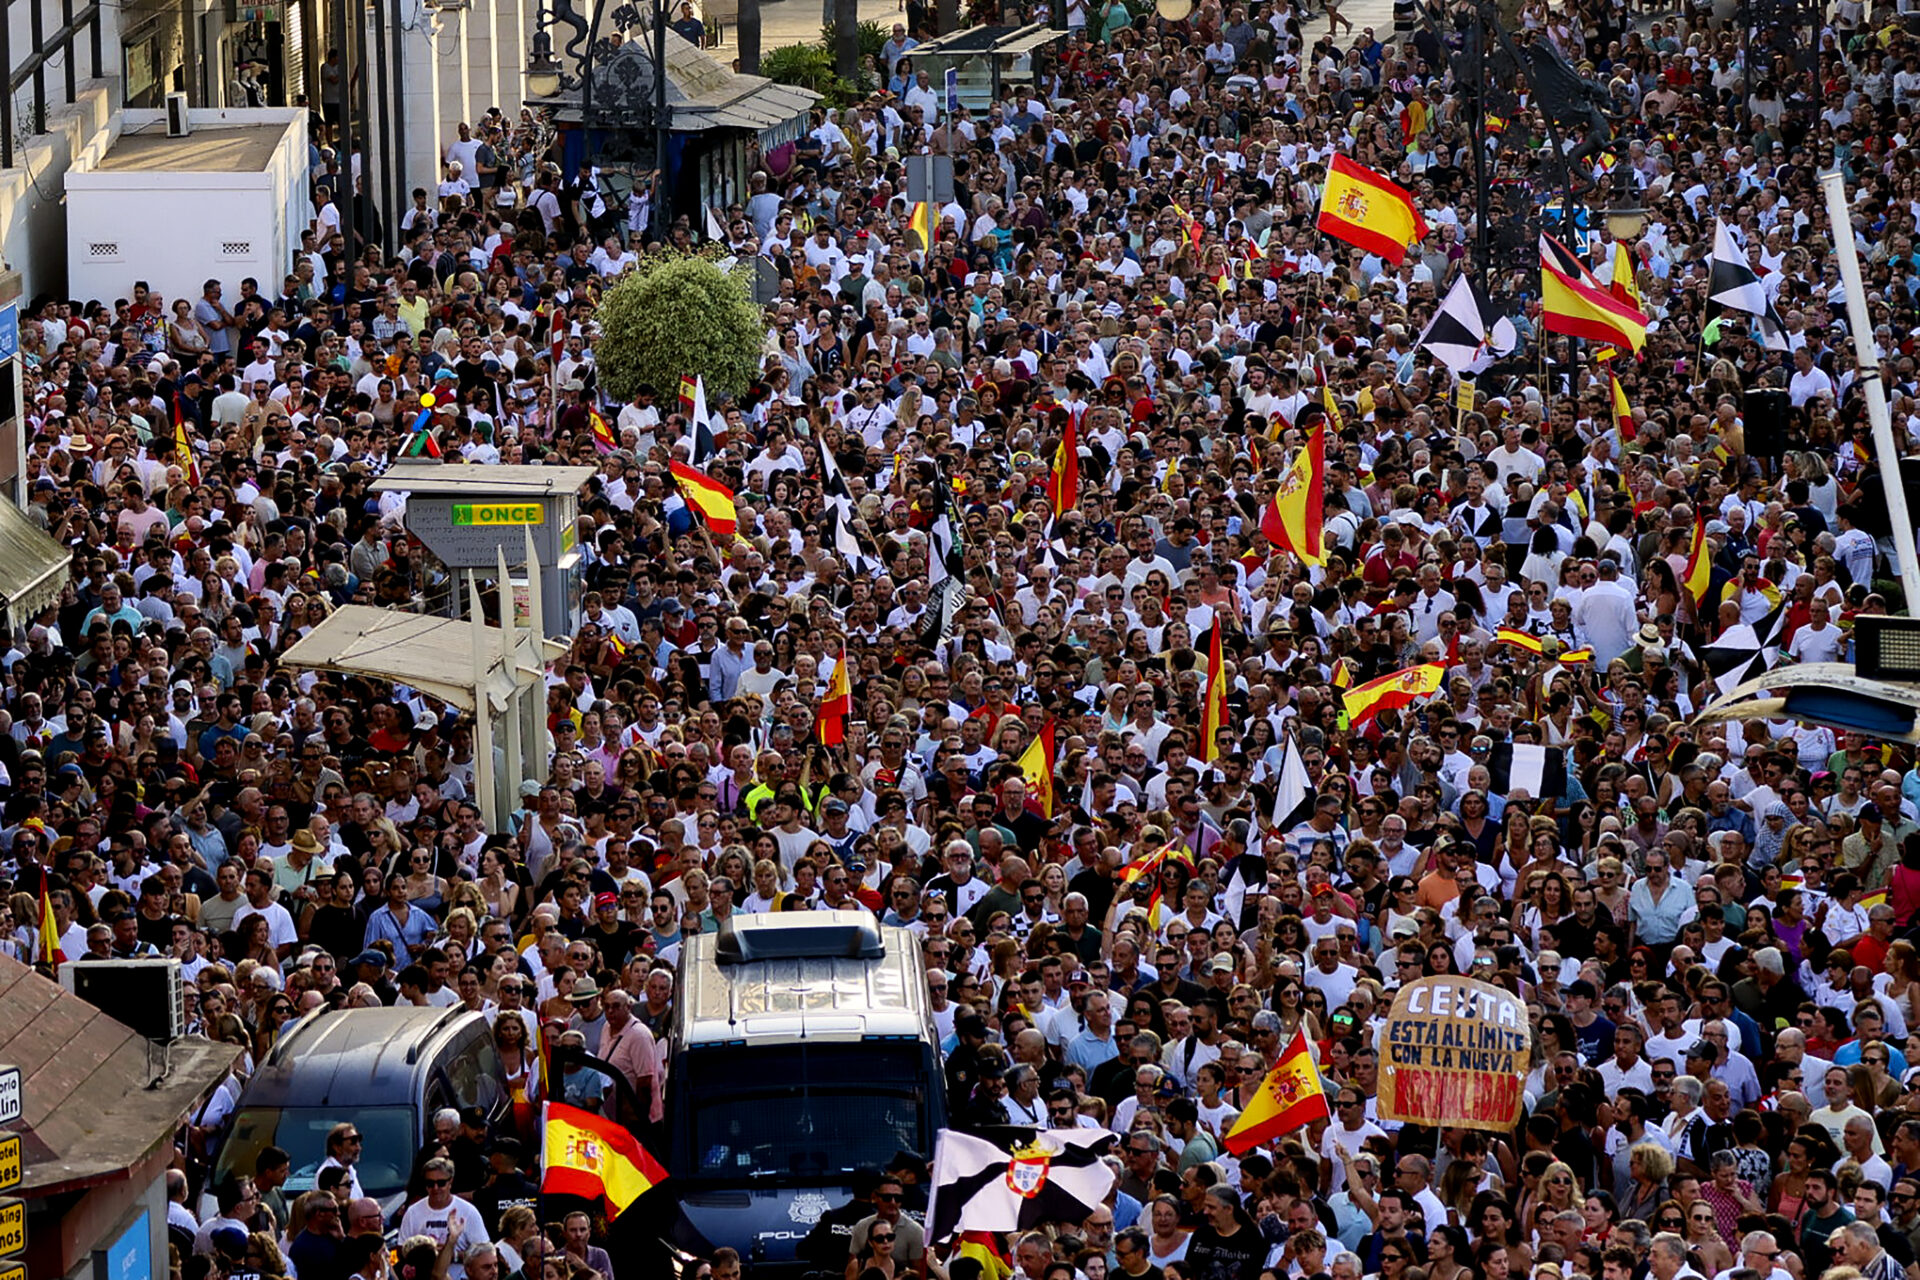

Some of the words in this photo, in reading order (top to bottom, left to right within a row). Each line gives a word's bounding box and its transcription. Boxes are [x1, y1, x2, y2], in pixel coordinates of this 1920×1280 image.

[480, 507, 536, 522] ONCE
[1407, 985, 1517, 1028] CEUTA
[1390, 1018, 1439, 1045] ESTÁ
[1442, 1023, 1464, 1047] AL
[1391, 1044, 1422, 1065] CON
[1431, 1047, 1453, 1067] LA
[1459, 1049, 1513, 1073] NUEVA
